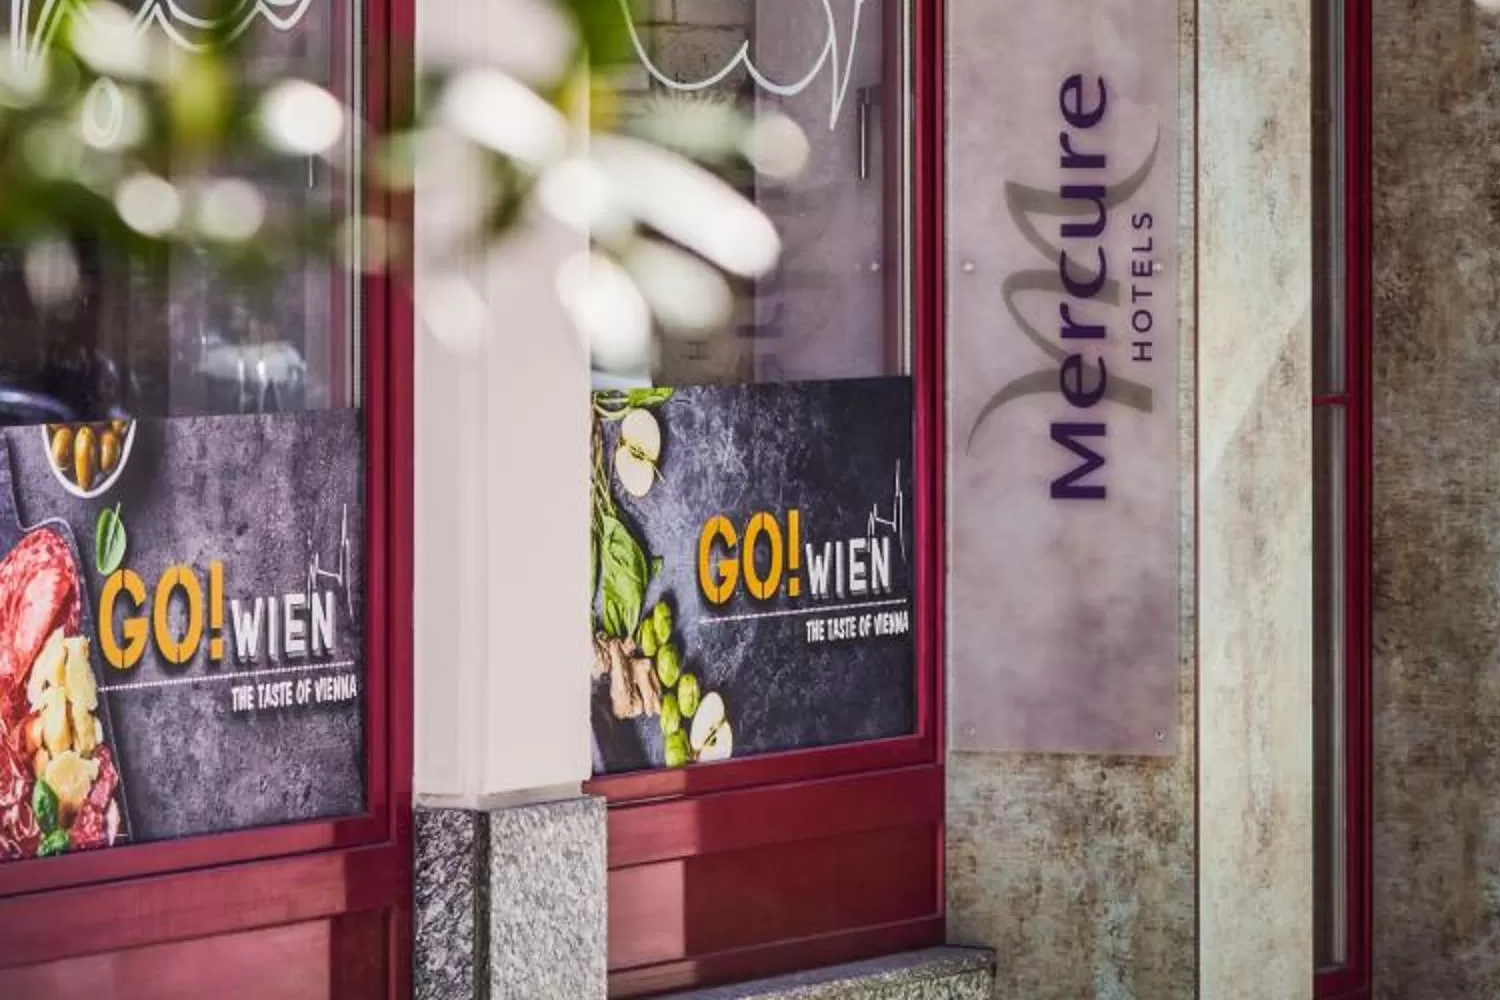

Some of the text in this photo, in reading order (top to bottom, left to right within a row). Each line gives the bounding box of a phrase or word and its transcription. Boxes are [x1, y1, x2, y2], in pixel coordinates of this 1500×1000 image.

[1050, 73, 1107, 501] Mercure
[1131, 211, 1154, 363] HOTELS
[698, 508, 892, 606] GO! WIEN
[98, 559, 336, 670] GO! WIEN
[806, 610, 909, 643] THE TASTE OF VIENNA
[232, 674, 358, 712] THE TASTE OF VIENNA
